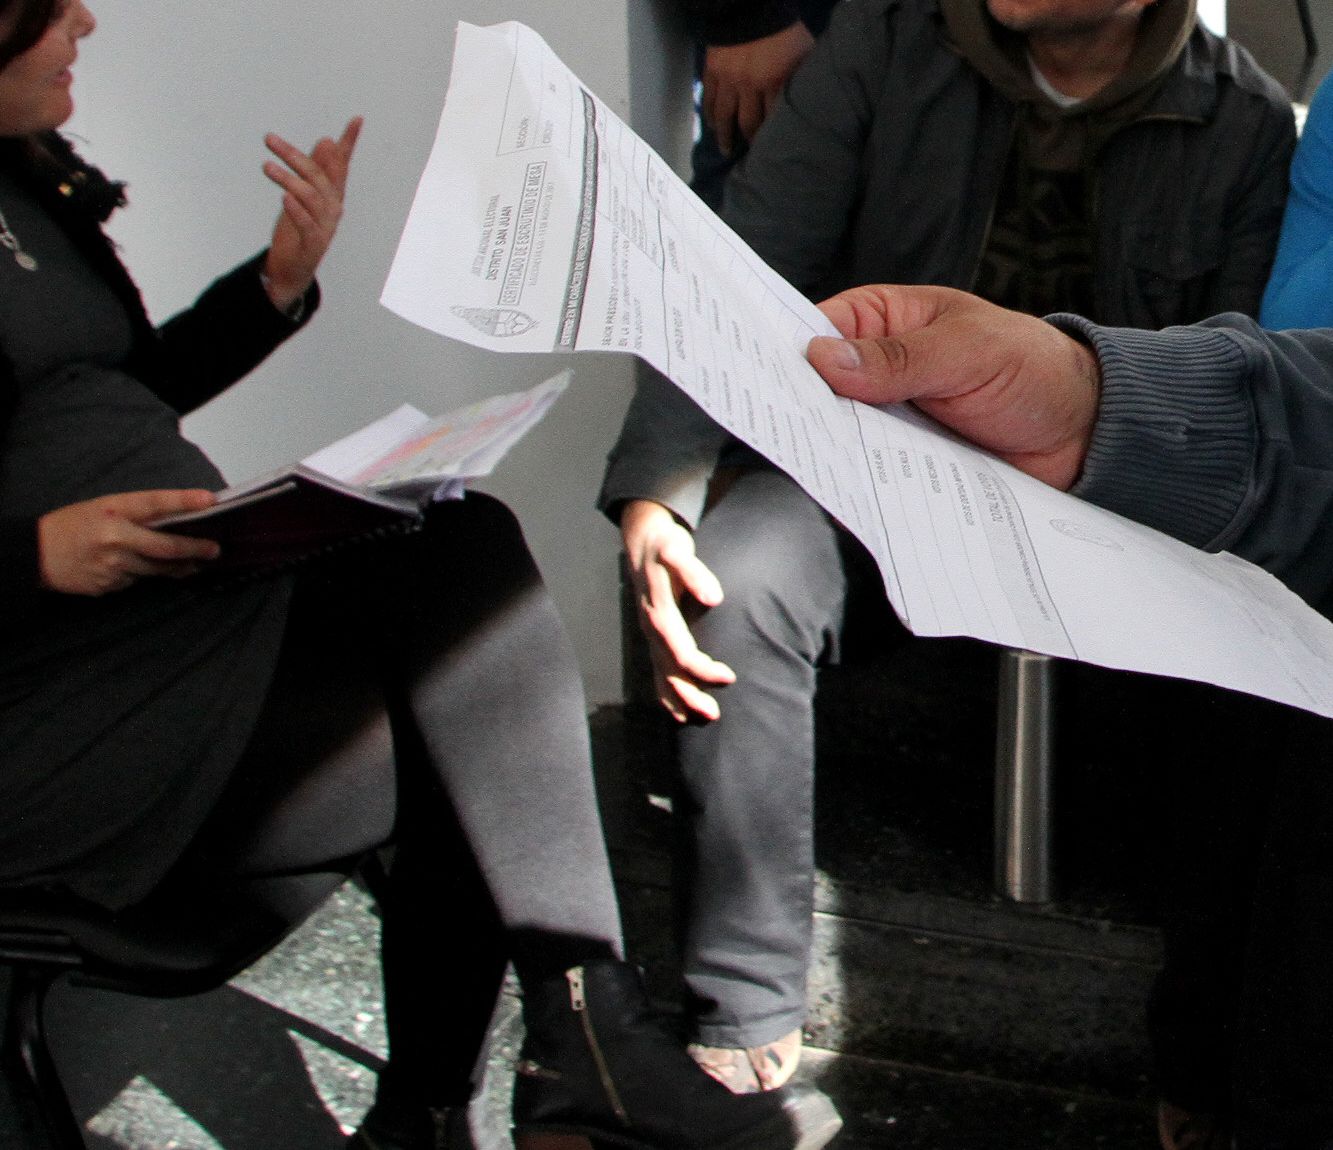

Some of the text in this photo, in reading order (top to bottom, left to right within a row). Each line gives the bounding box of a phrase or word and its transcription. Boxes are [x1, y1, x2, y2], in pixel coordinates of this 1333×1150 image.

[486, 205, 513, 281] DISTRITO SAN JUAN
[517, 198, 537, 244] ESCRUTINIO
[528, 164, 543, 185] MESA
